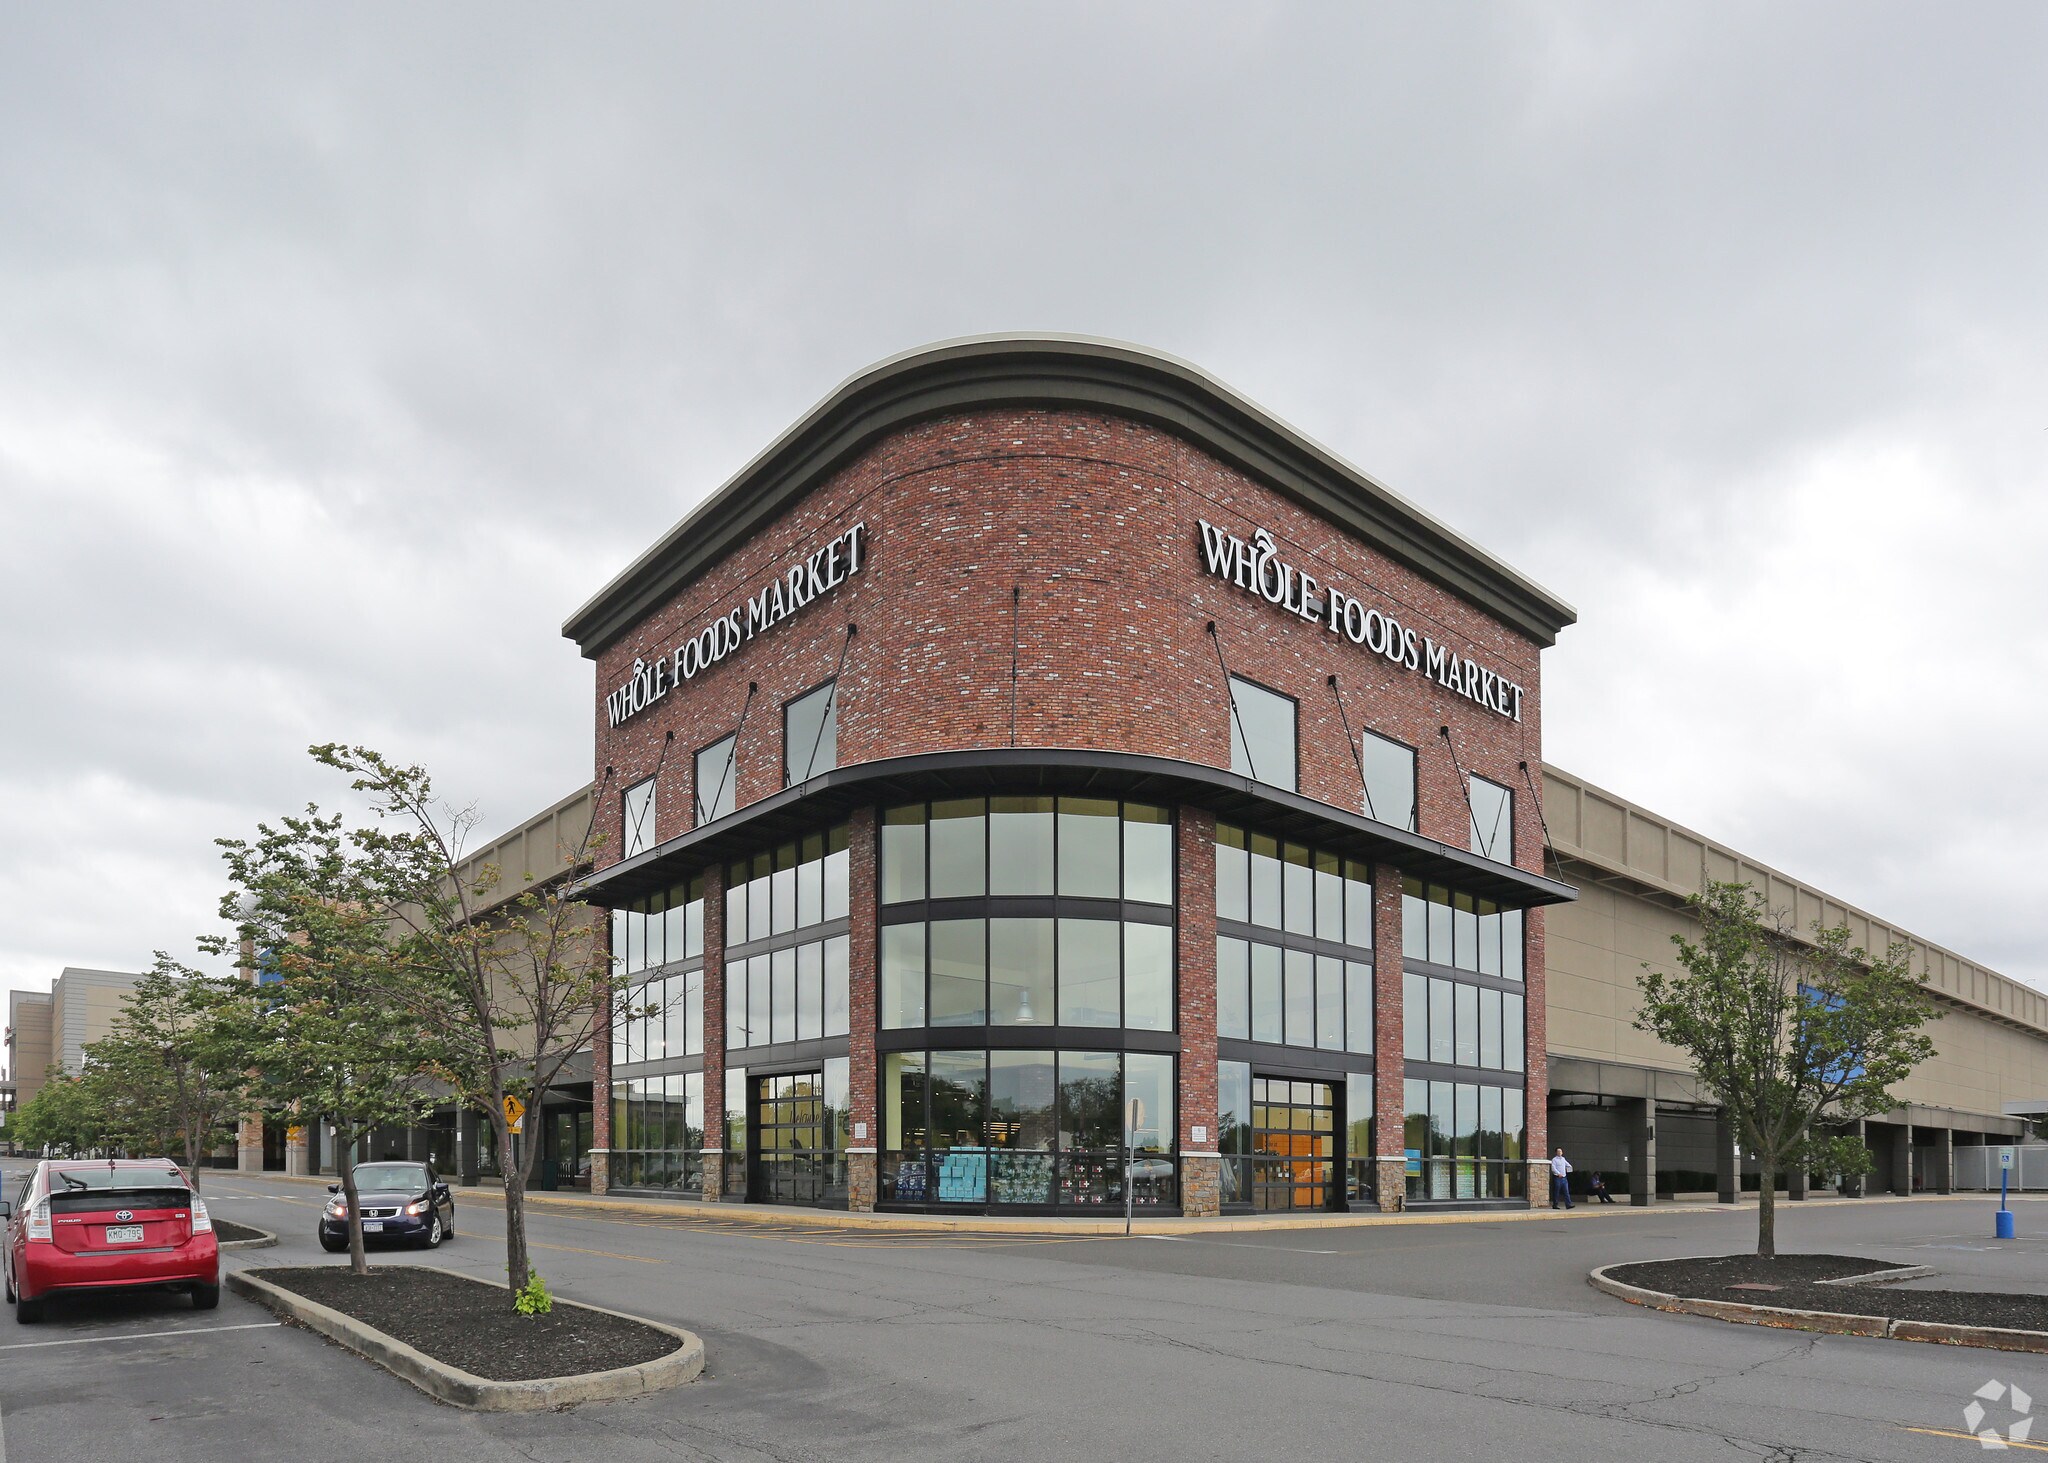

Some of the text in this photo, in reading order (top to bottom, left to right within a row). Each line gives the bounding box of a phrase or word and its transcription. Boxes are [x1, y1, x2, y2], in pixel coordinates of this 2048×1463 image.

[606, 521, 865, 729] WHOLE FOODS MARKET
[1198, 518, 1524, 722] WHOLE FOODS MARKET
